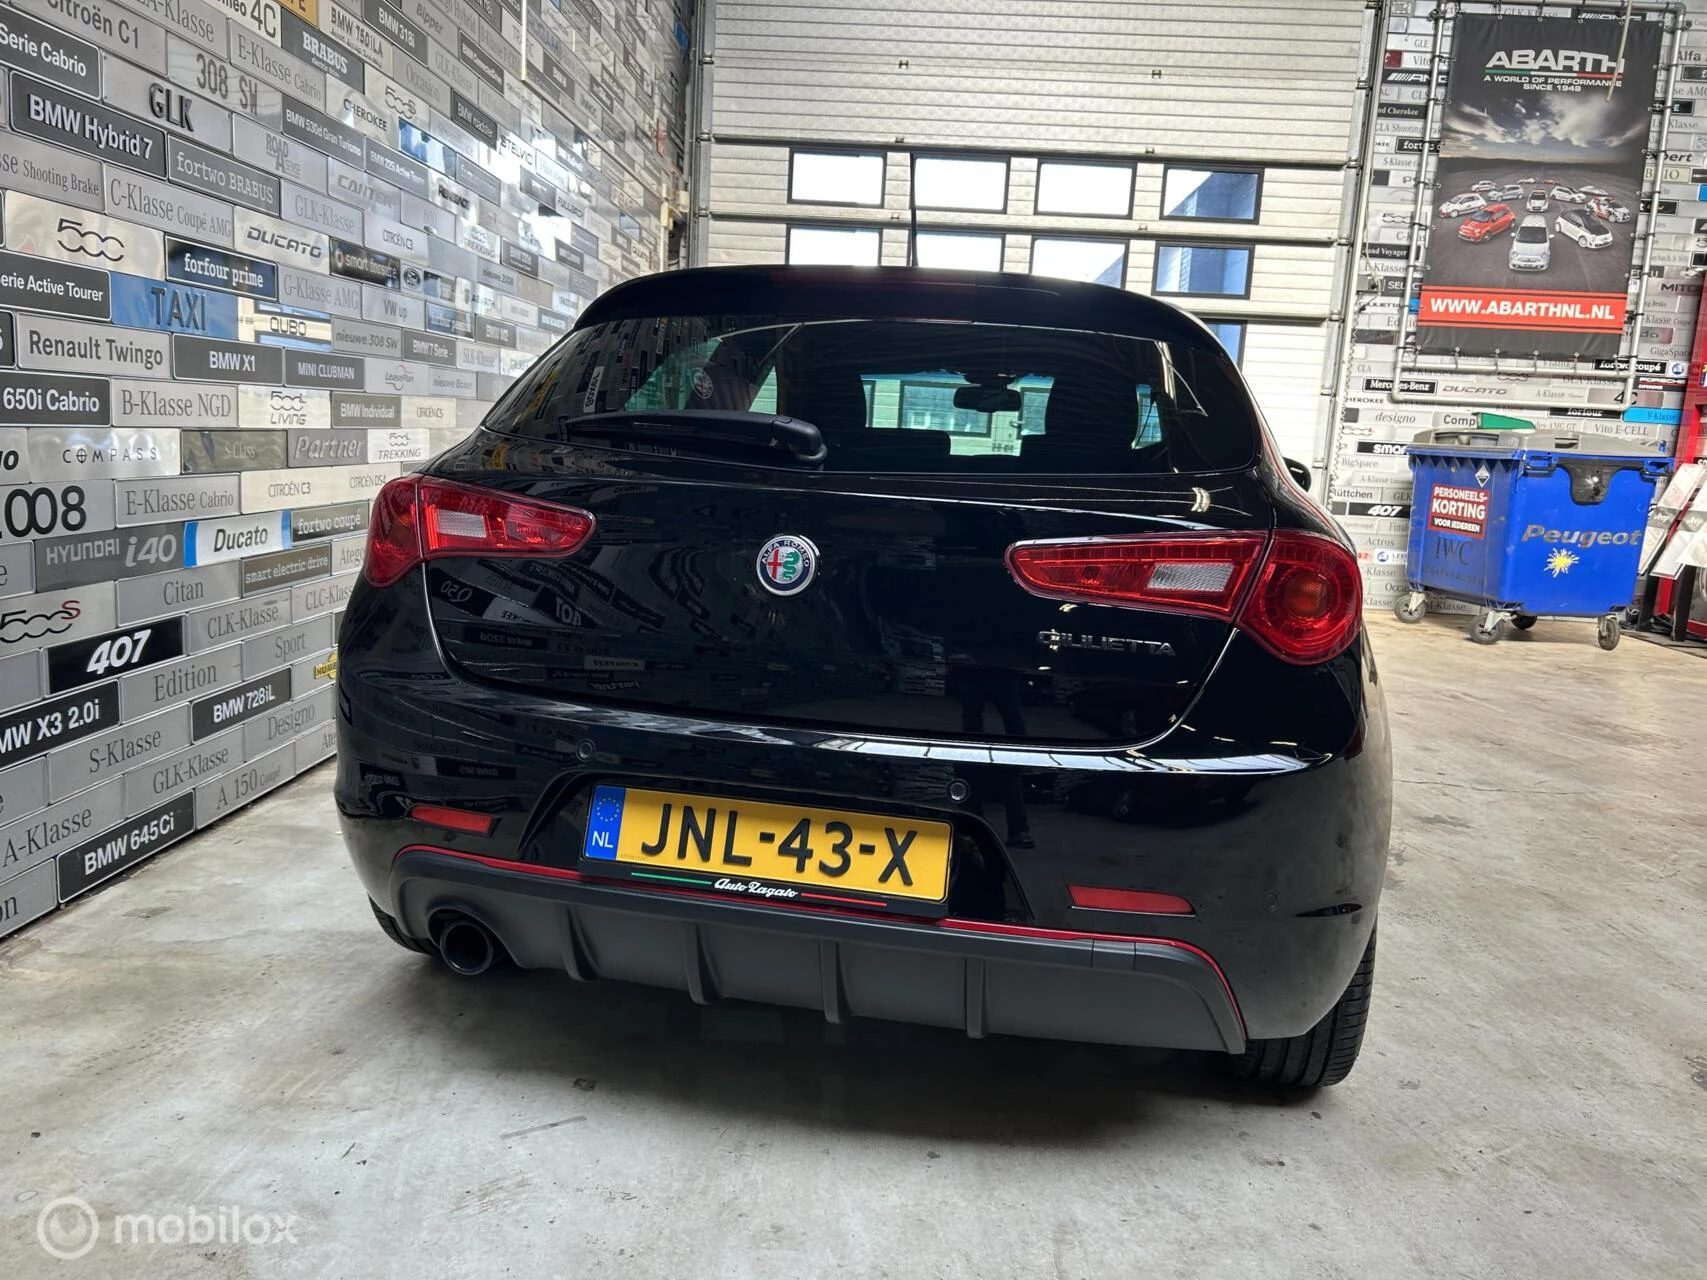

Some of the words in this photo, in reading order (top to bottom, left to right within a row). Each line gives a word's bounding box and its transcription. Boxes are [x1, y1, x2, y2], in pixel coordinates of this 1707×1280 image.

[250, 0, 276, 38] 4C
[329, 5, 353, 37] BMW
[378, 7, 400, 36] BMW
[399, 23, 415, 49] 318i
[416, 3, 444, 34] Bipper
[118, 19, 139, 49] C1
[40, 41, 87, 77] Cabrio
[238, 33, 292, 85] E-Klasse
[303, 31, 348, 75] BRABUS
[1485, 49, 1626, 74] ABARTH
[197, 53, 228, 99] 308
[1494, 76, 1530, 84] WORLD
[1532, 77, 1546, 85] OF
[1547, 78, 1623, 88] PERFORMANCE
[1523, 83, 1554, 92] SINCE
[1556, 85, 1582, 93] 1949
[148, 82, 194, 132] GLK
[343, 98, 388, 132] CHEROKEE
[28, 93, 82, 136] BMW
[84, 114, 141, 157] Hybrid
[142, 138, 154, 161] 7
[286, 108, 306, 129] BMW
[322, 126, 338, 145] Gran
[22, 158, 69, 193] Shooting
[70, 176, 100, 198] Brake
[176, 151, 227, 188] fortwo
[228, 171, 275, 205] BRABUS
[110, 178, 174, 222] C-Klasse
[177, 205, 207, 234] Coupé
[209, 216, 232, 239] AMG
[57, 217, 125, 262] 500
[247, 226, 322, 259] DUCATO
[184, 253, 228, 281] forfour
[232, 266, 264, 288] prime
[26, 274, 64, 297] Active
[66, 281, 104, 302] Tourer
[151, 286, 207, 332] TAXI
[1429, 297, 1615, 320] WWW.ABARTHNL.NL
[269, 316, 307, 337] QUBO
[335, 329, 368, 346] nieuwe
[367, 333, 385, 348] 308
[385, 336, 398, 349] SW
[28, 329, 102, 362] Renault
[104, 338, 163, 370] Twingo
[209, 351, 242, 371] BMW
[242, 354, 256, 372] X1
[298, 362, 317, 377] MINI
[317, 364, 355, 380] CLUBMAN
[3, 387, 43, 410] 650i
[46, 390, 100, 413] Cabrio
[121, 389, 194, 417] B-Klasse
[197, 394, 232, 418] NGD
[1442, 385, 1508, 395] DUCATO
[270, 413, 307, 426] LIVING
[340, 402, 361, 418] BMW
[361, 403, 396, 419] Individual
[1375, 411, 1416, 425] designo
[1443, 414, 1476, 428] Comp
[1595, 424, 1613, 434] Vito
[1615, 425, 1649, 436] E-CELL
[293, 436, 365, 460] Partner
[378, 448, 422, 461] TREKKING
[1341, 457, 1379, 469] BigSpace
[125, 489, 196, 517] E-Klasse
[200, 491, 235, 509] Cabrio
[268, 482, 300, 498] CITROËN
[300, 481, 312, 495] C3
[1433, 486, 1489, 503] PERSONEELS-
[0, 485, 87, 539] 008
[297, 516, 332, 536] fortwo
[333, 512, 362, 531] coupé
[1367, 504, 1403, 517] 407
[1431, 498, 1487, 521] KORTING
[213, 525, 269, 553] Ducato
[1433, 517, 1453, 528] VOOR
[1451, 519, 1481, 533] IEDEREEN
[1520, 524, 1642, 550] Peugeot
[46, 537, 121, 567] HYUNDAI
[123, 533, 178, 568] i40
[761, 542, 780, 564] ALFA
[783, 540, 810, 567] ROMEO
[245, 568, 272, 584] smart
[272, 560, 307, 579] electric
[307, 555, 329, 570] drive
[163, 580, 205, 606] Citan
[207, 605, 279, 639] CLK-Klasse
[86, 629, 152, 676] 407
[274, 632, 306, 660] Sport
[1037, 629, 1177, 657] GIULIETTA
[152, 661, 218, 703] Edition
[213, 694, 244, 724] BMW
[246, 684, 276, 709] 728iL
[36, 711, 62, 742] X3
[67, 699, 100, 730] 2.0i
[267, 704, 316, 741] Designo
[89, 729, 163, 774] S-Klasse
[153, 747, 229, 795] GLK-Klasse
[216, 785, 229, 811] A
[234, 767, 259, 801] 150
[2, 807, 93, 869] A-Klasse
[84, 834, 128, 876] BMW
[130, 812, 175, 851] 645Ci
[591, 830, 614, 850] NL
[640, 803, 918, 887] JNL-43-X
[713, 878, 747, 892] Auto
[747, 881, 799, 899] Zagato
